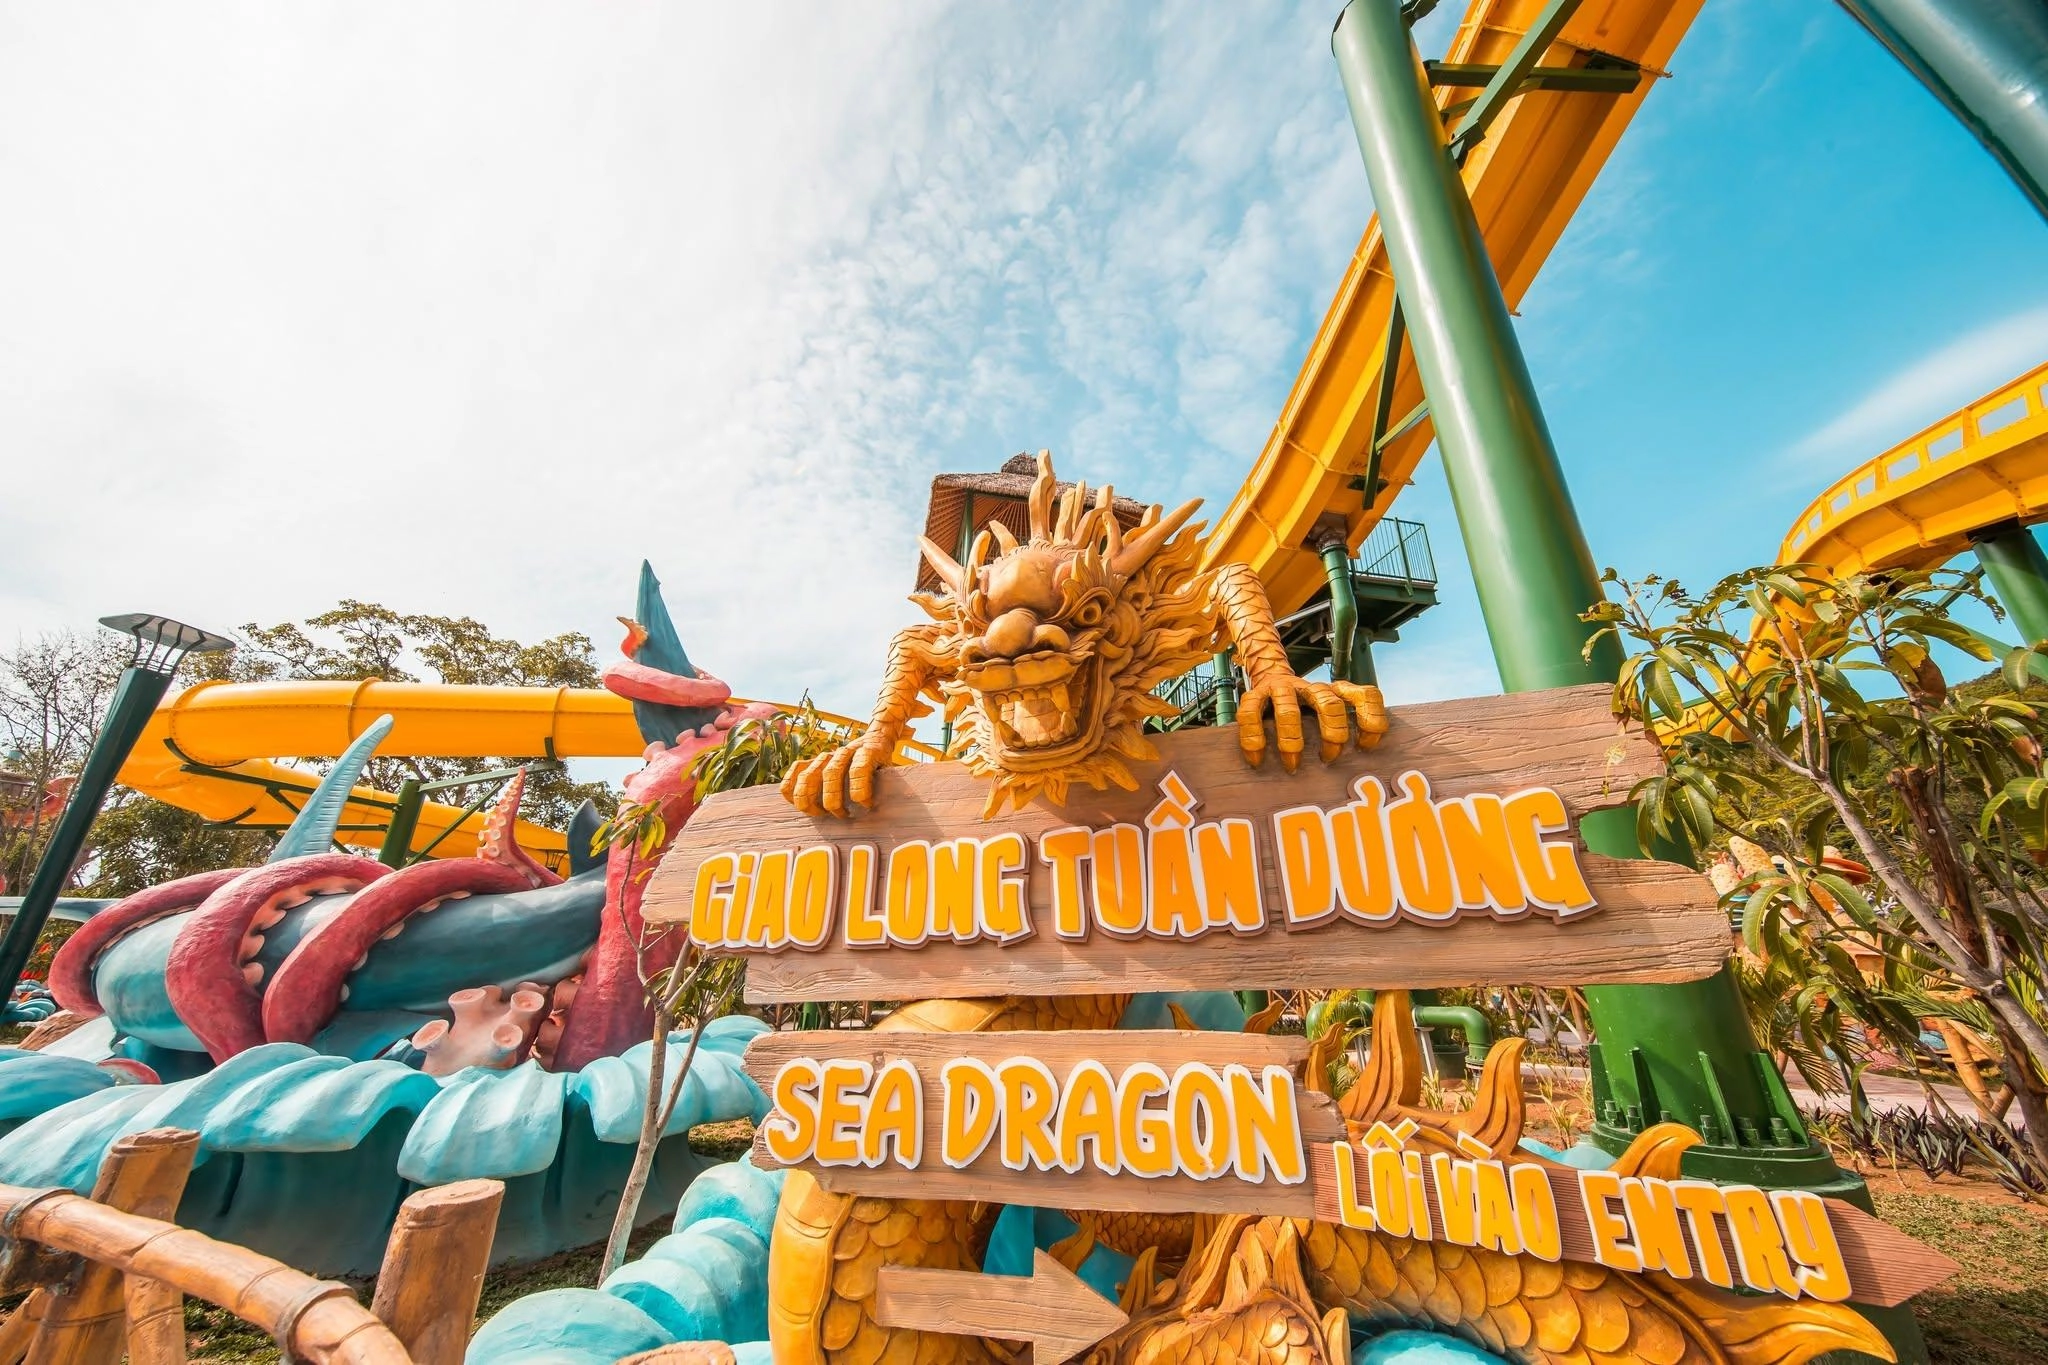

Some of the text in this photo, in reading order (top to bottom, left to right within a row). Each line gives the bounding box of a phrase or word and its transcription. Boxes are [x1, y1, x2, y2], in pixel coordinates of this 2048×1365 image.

[845, 833, 1032, 946] LONG
[1039, 770, 1264, 936] TUẦN
[765, 1056, 1307, 1184] SEA DRAGON
[1430, 1130, 1562, 1262] VÀO
